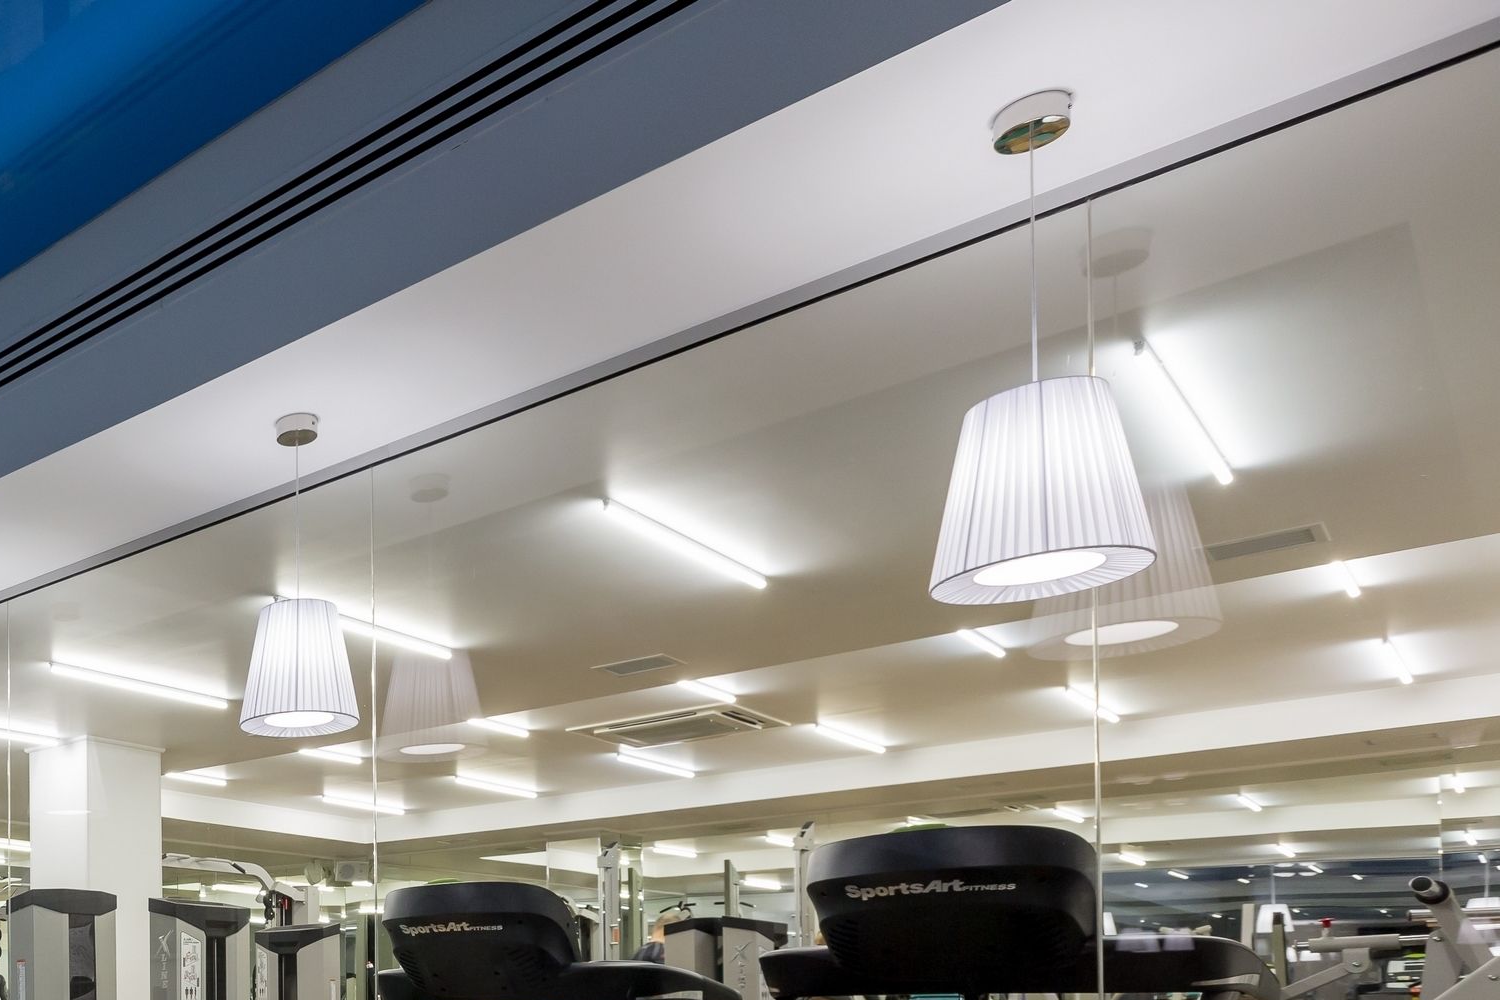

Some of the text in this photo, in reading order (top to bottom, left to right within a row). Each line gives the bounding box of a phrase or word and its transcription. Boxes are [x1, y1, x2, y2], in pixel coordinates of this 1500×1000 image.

[844, 879, 1017, 901] SportsArt FITNESS
[399, 921, 470, 937] SportsArt
